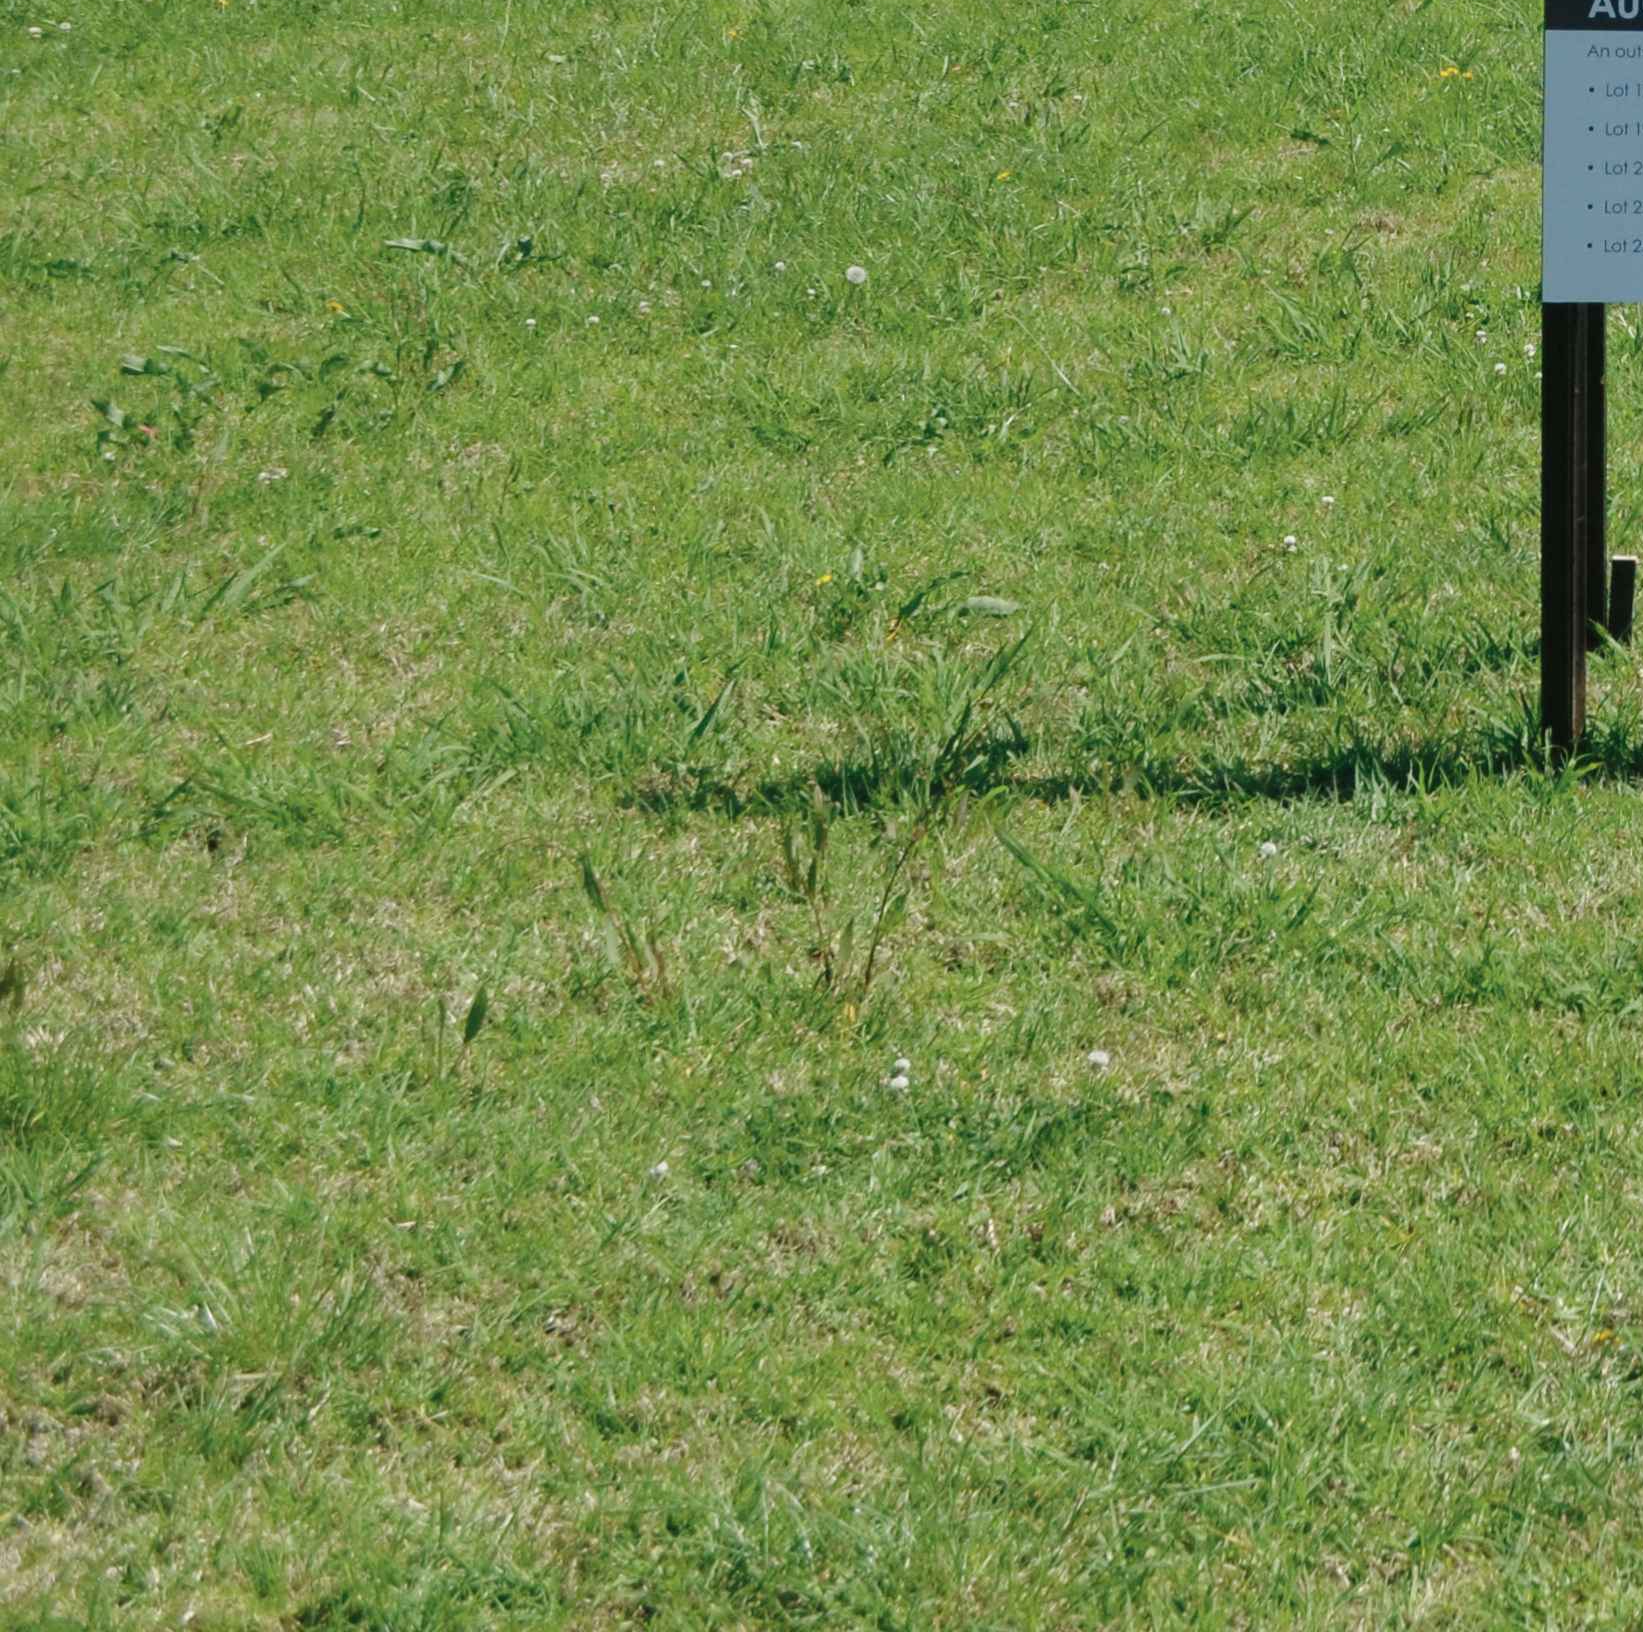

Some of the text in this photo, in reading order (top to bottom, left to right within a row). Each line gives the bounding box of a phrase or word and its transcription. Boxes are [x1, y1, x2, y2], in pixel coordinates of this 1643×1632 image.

[1586, 43, 1610, 58] An
[1605, 83, 1630, 98] Lot
[1604, 122, 1629, 137] Lot
[1604, 161, 1629, 176] Lot
[1604, 200, 1628, 215] Lot
[1603, 239, 1628, 254] Lot
